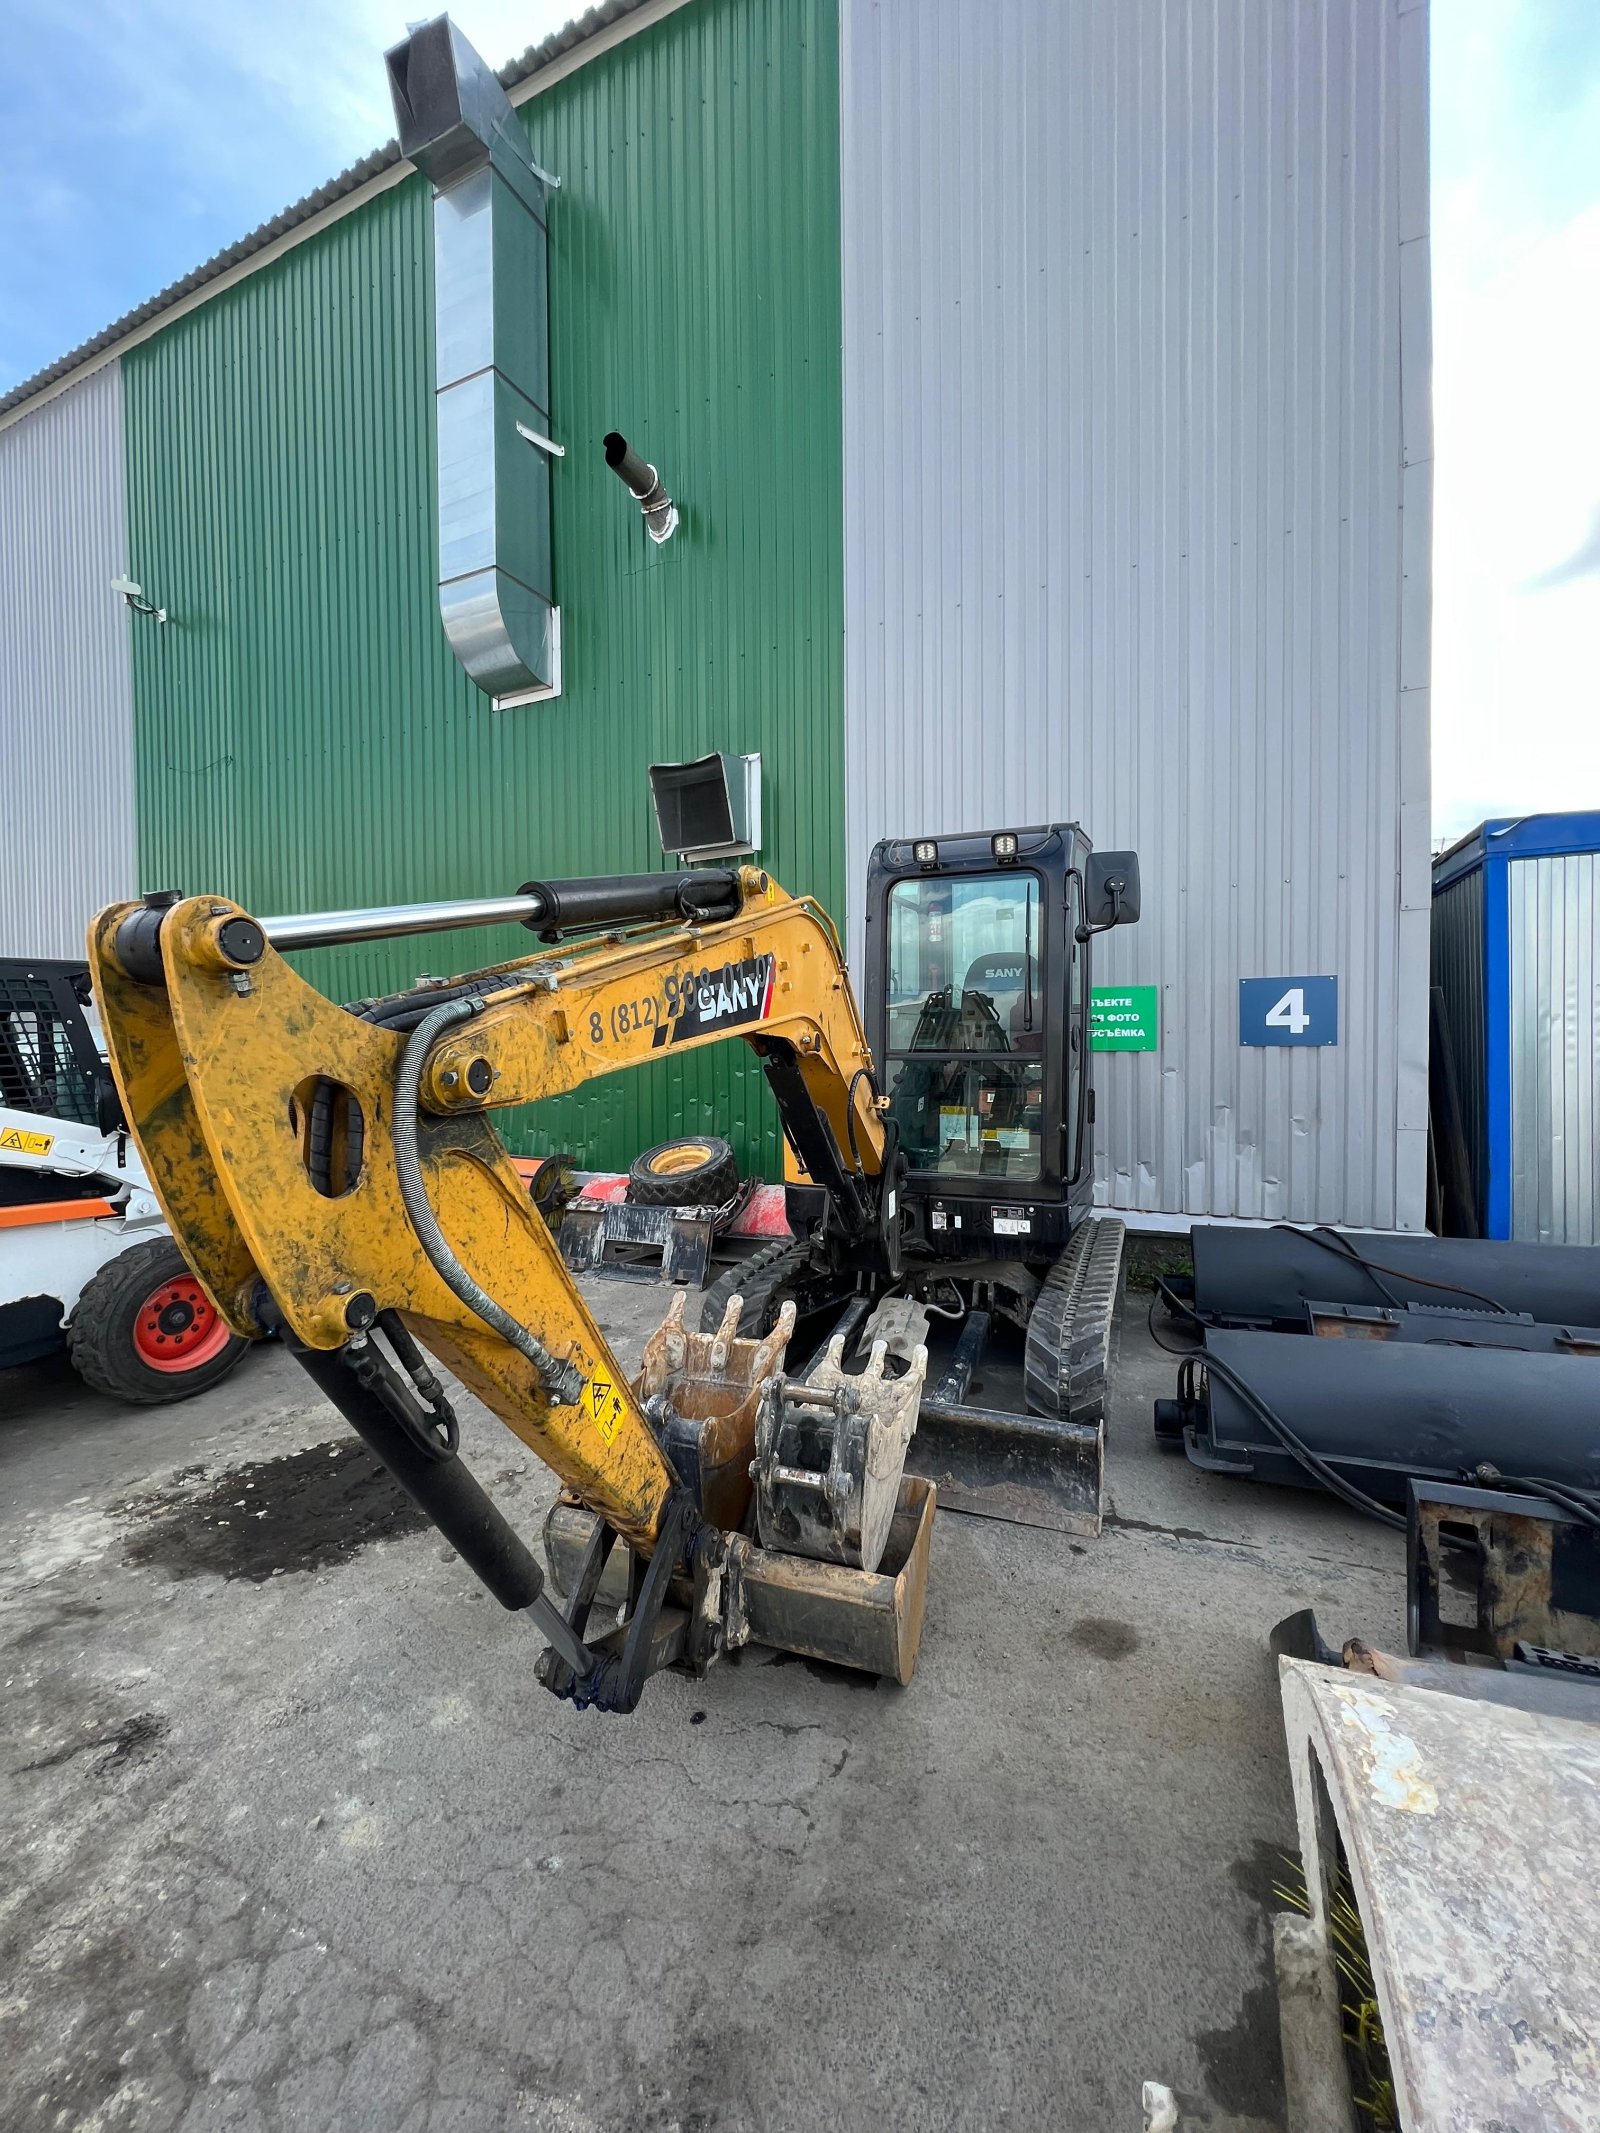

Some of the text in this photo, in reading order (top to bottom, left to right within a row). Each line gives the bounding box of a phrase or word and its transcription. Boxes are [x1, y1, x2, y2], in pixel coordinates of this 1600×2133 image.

[985, 968, 1022, 977] SANY
[589, 1011, 604, 1043] 8
[611, 996, 660, 1042] (812)
[698, 976, 760, 1022] SANY
[1107, 1013, 1140, 1022] ФОТО
[1266, 989, 1309, 1033] 4
